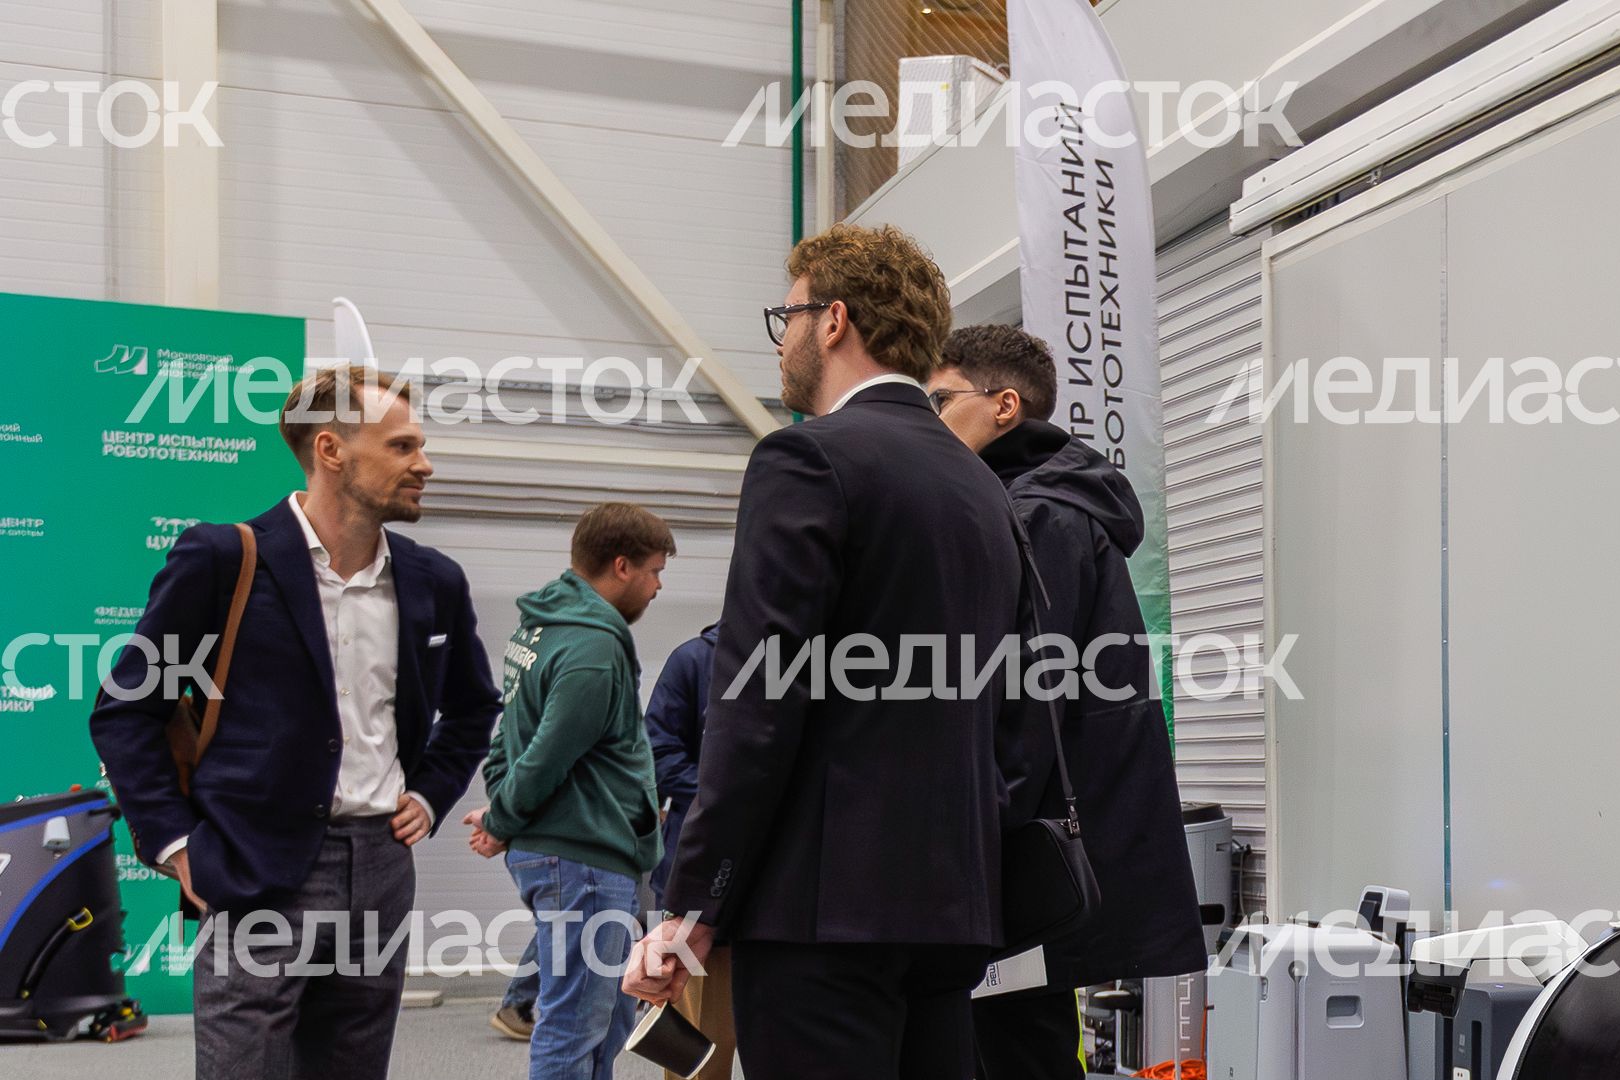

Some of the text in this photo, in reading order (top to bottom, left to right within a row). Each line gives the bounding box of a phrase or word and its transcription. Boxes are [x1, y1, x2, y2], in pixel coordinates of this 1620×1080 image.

[1054, 102, 1093, 386] ИСПЫТАНИЙ
[1095, 159, 1126, 469] БОТОТЕХНИКИ
[102, 430, 257, 451] ЦЕНТР ИСПЫТАНИЙ
[102, 445, 239, 464] РОБОТОТЕХНИКИ
